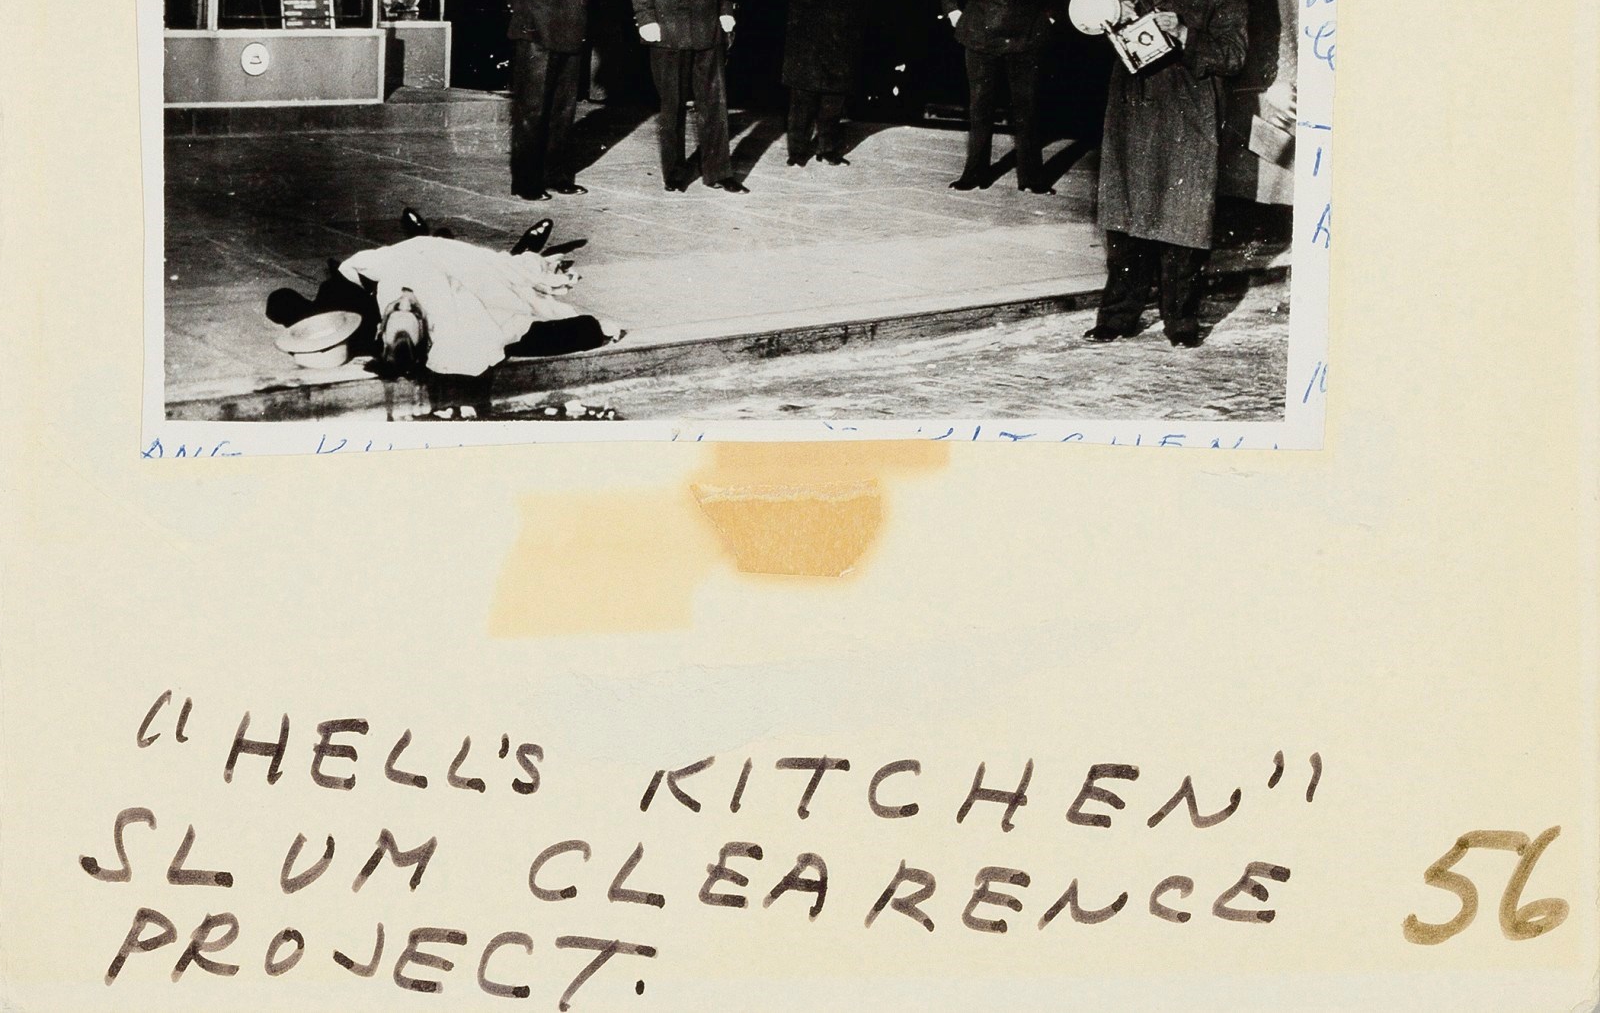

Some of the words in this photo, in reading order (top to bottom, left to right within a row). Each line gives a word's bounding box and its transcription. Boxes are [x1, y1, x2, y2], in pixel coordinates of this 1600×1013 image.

[79, 807, 437, 894] SLUM
[527, 840, 1291, 932] CLEARENCE
[1403, 826, 1569, 945] 56
[105, 907, 657, 1013] PROJECT.
